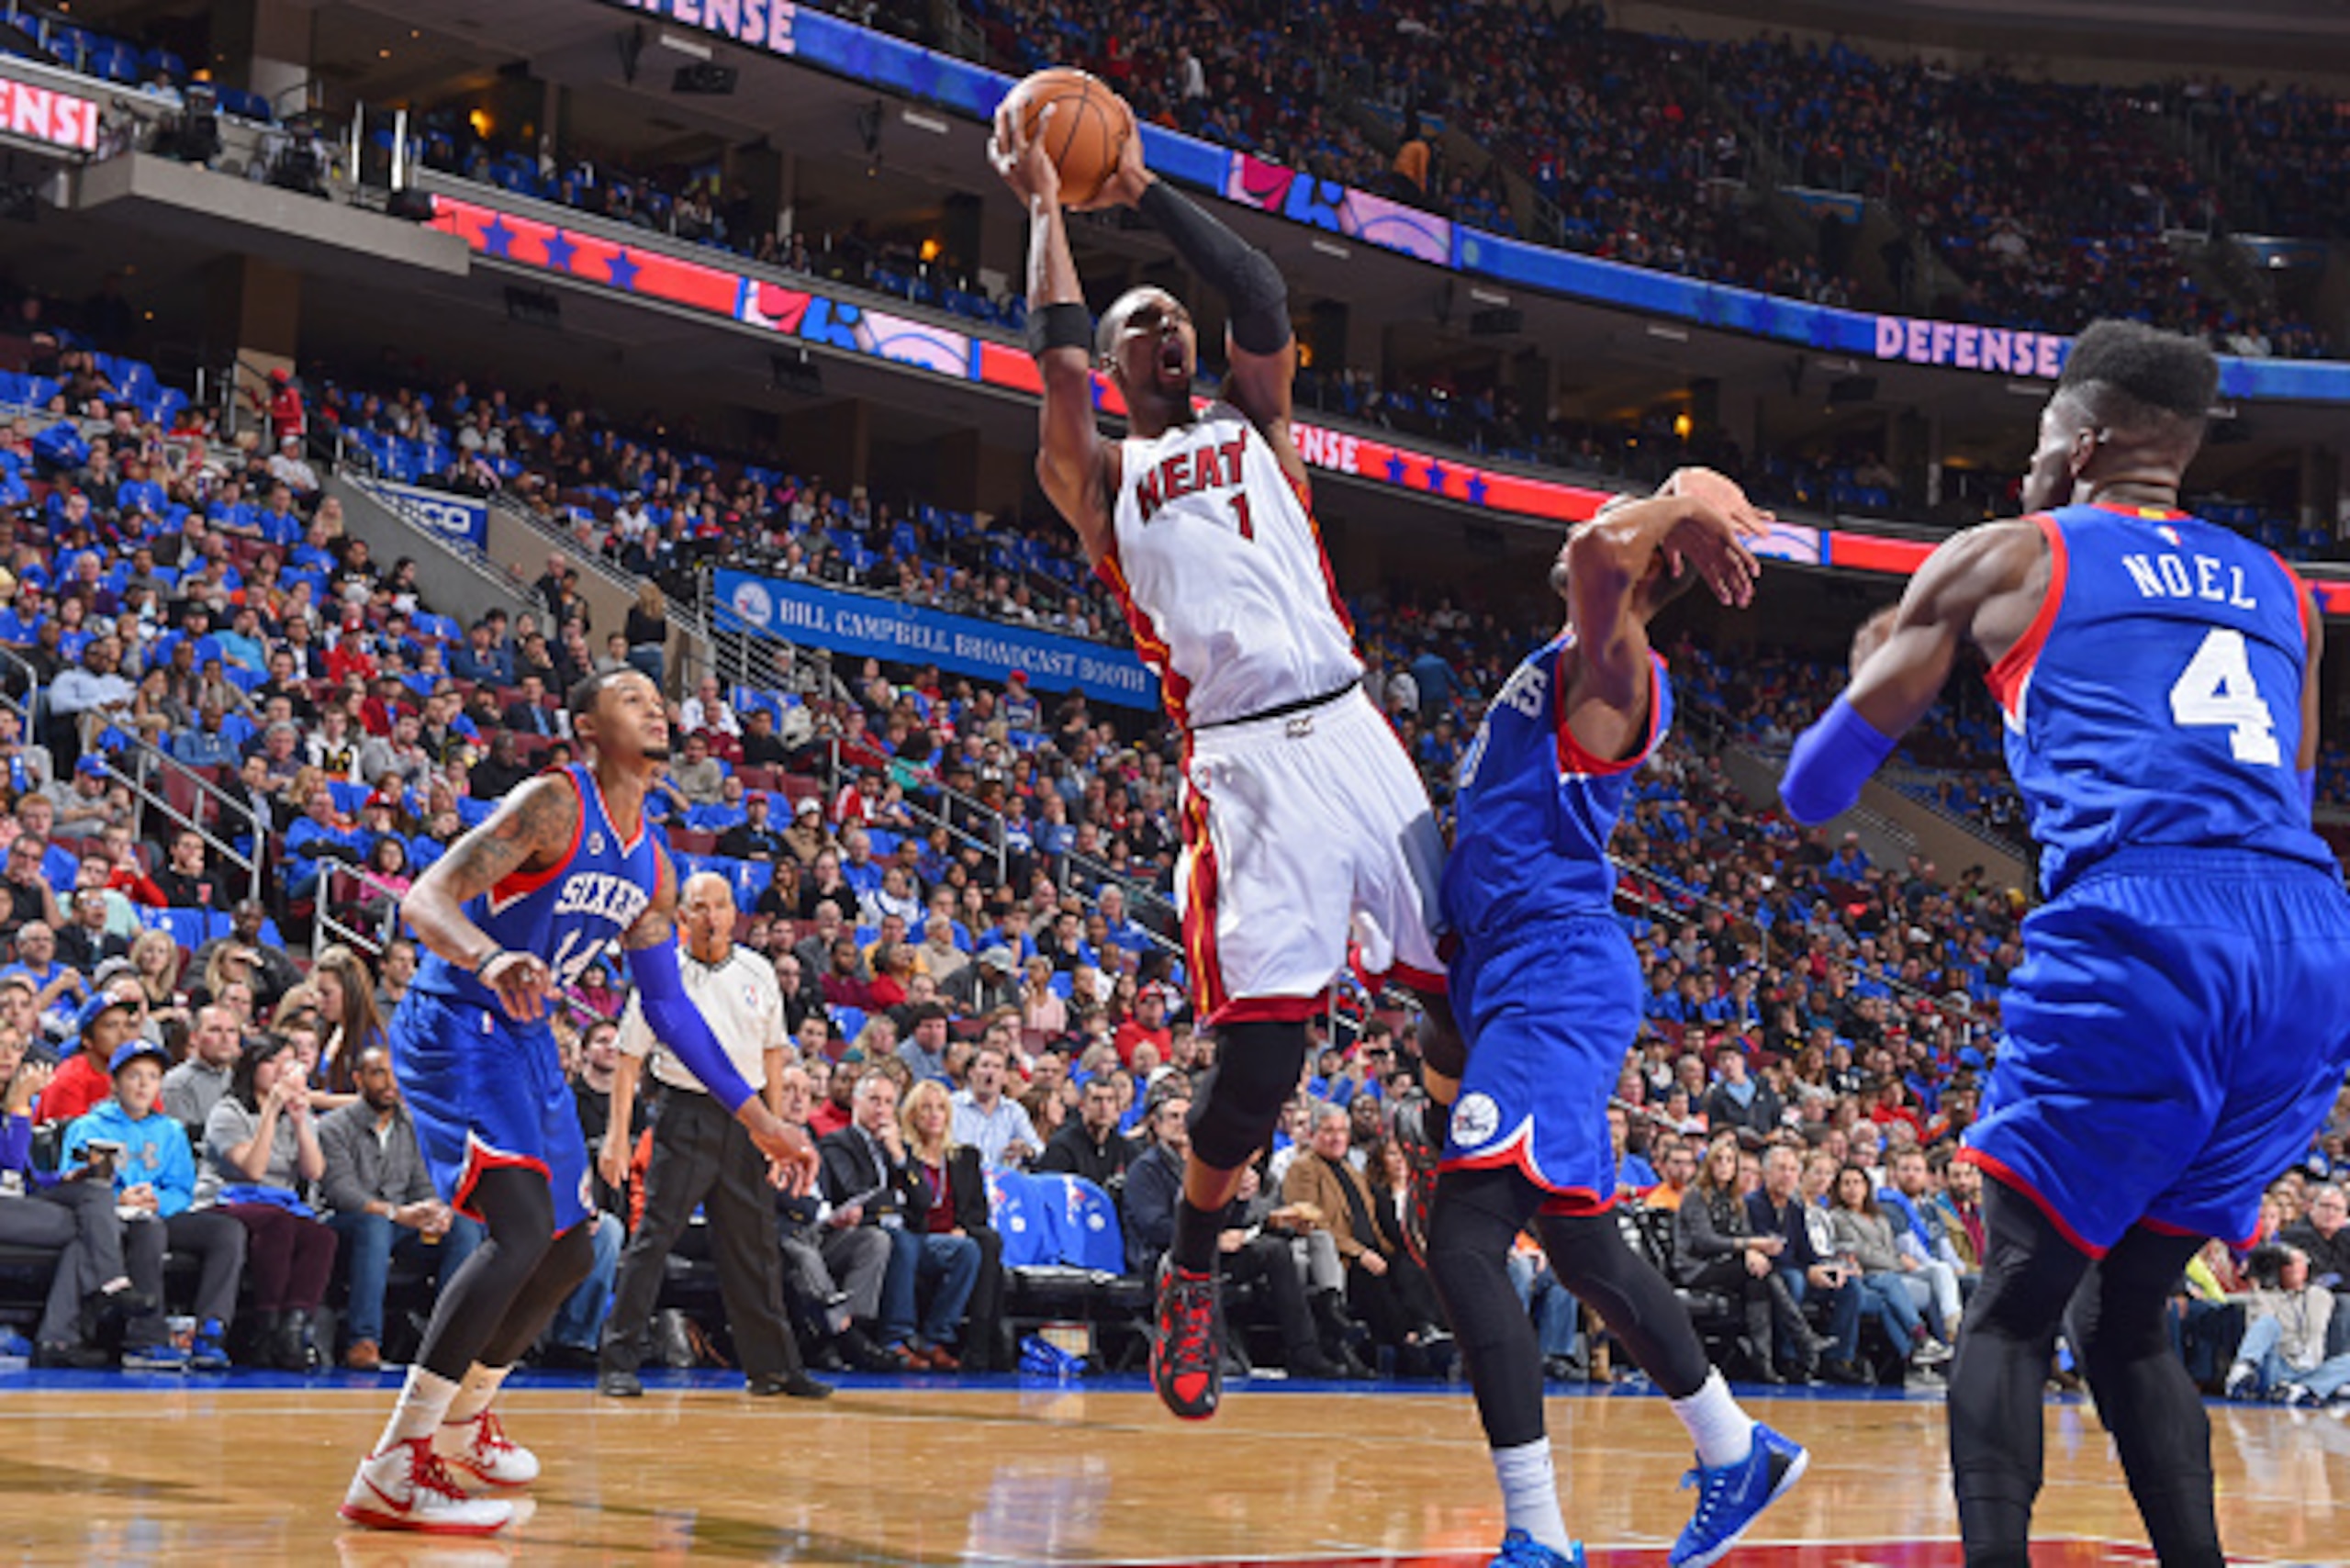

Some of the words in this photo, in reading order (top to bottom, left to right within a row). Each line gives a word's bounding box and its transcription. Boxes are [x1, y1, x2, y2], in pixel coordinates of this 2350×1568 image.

[1875, 315, 2060, 379] DEFENSE
[1136, 426, 1248, 527] HEAT
[1227, 489, 1254, 543] 1
[2122, 554, 2256, 610] NOEL
[780, 598, 831, 633] BILL
[835, 610, 951, 653] CAMPBELL
[955, 633, 1077, 678] BROADCAST
[1079, 655, 1146, 693] BOOTH
[2168, 627, 2281, 767] 4
